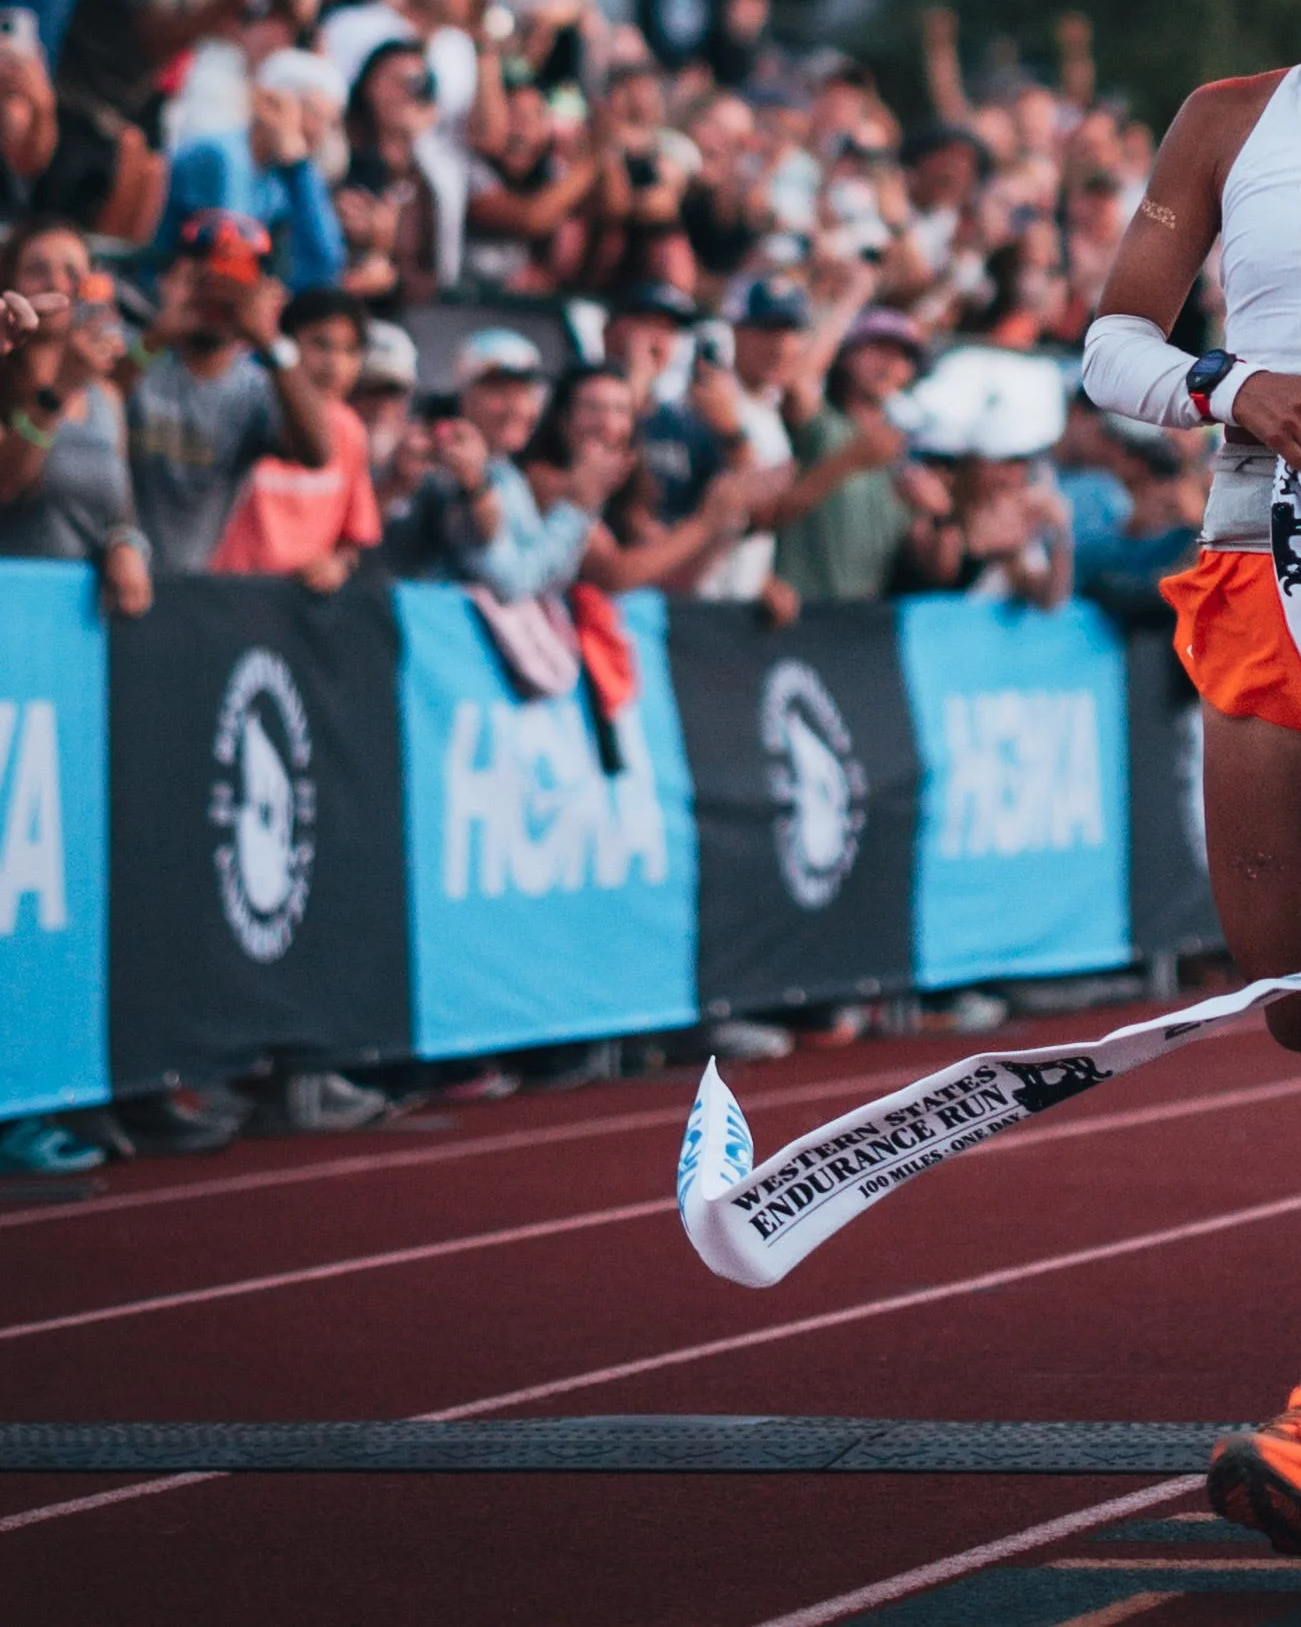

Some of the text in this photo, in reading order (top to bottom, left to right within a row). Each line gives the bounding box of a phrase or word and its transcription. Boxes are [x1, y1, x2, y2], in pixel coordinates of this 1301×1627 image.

[730, 1122, 881, 1212] WESTERN
[884, 1064, 998, 1127] STATES
[748, 1118, 937, 1241] ENDURANCE
[936, 1082, 1009, 1131] RUN
[857, 1174, 889, 1199] 100
[887, 1149, 944, 1184] MILES
[950, 1127, 988, 1152] ONE
